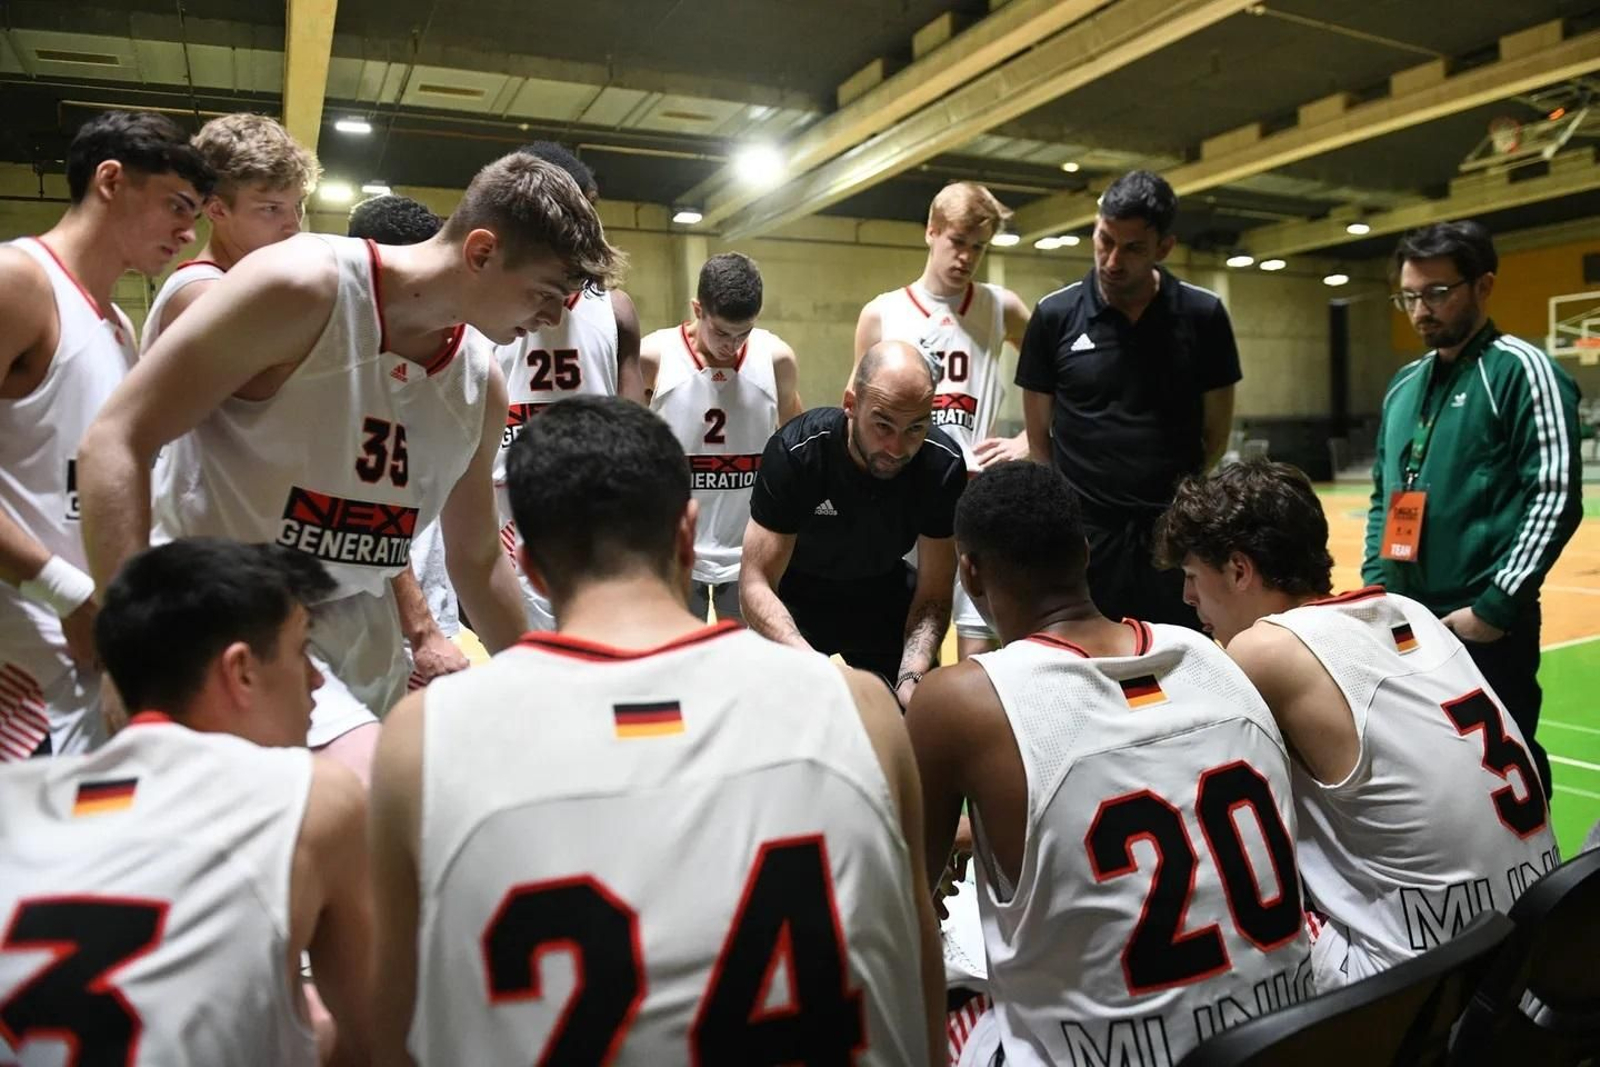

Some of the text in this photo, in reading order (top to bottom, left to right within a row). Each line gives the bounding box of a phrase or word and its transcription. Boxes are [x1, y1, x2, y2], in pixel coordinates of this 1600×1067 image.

[526, 348, 583, 392] 25
[703, 407, 728, 445] 2
[355, 415, 410, 488] 35
[1440, 687, 1548, 840] 3
[1083, 759, 1303, 997] 20
[480, 831, 870, 1067] 24
